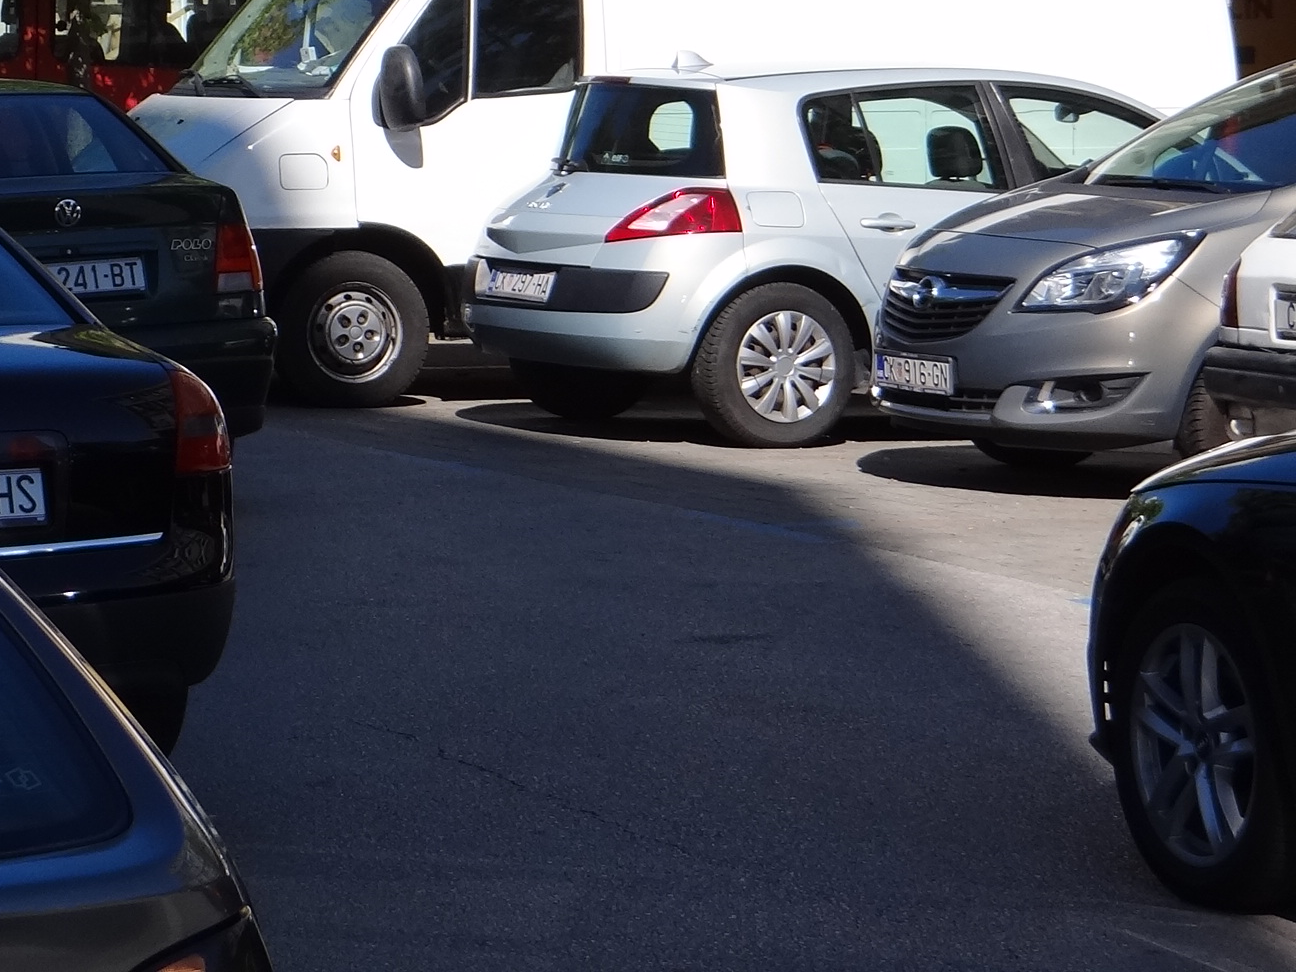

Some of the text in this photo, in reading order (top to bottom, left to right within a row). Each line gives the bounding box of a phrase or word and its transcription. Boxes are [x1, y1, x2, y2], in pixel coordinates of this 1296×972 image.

[171, 239, 212, 250] POLO
[1287, 301, 1296, 329] C
[884, 356, 949, 388] CK 916-GN
